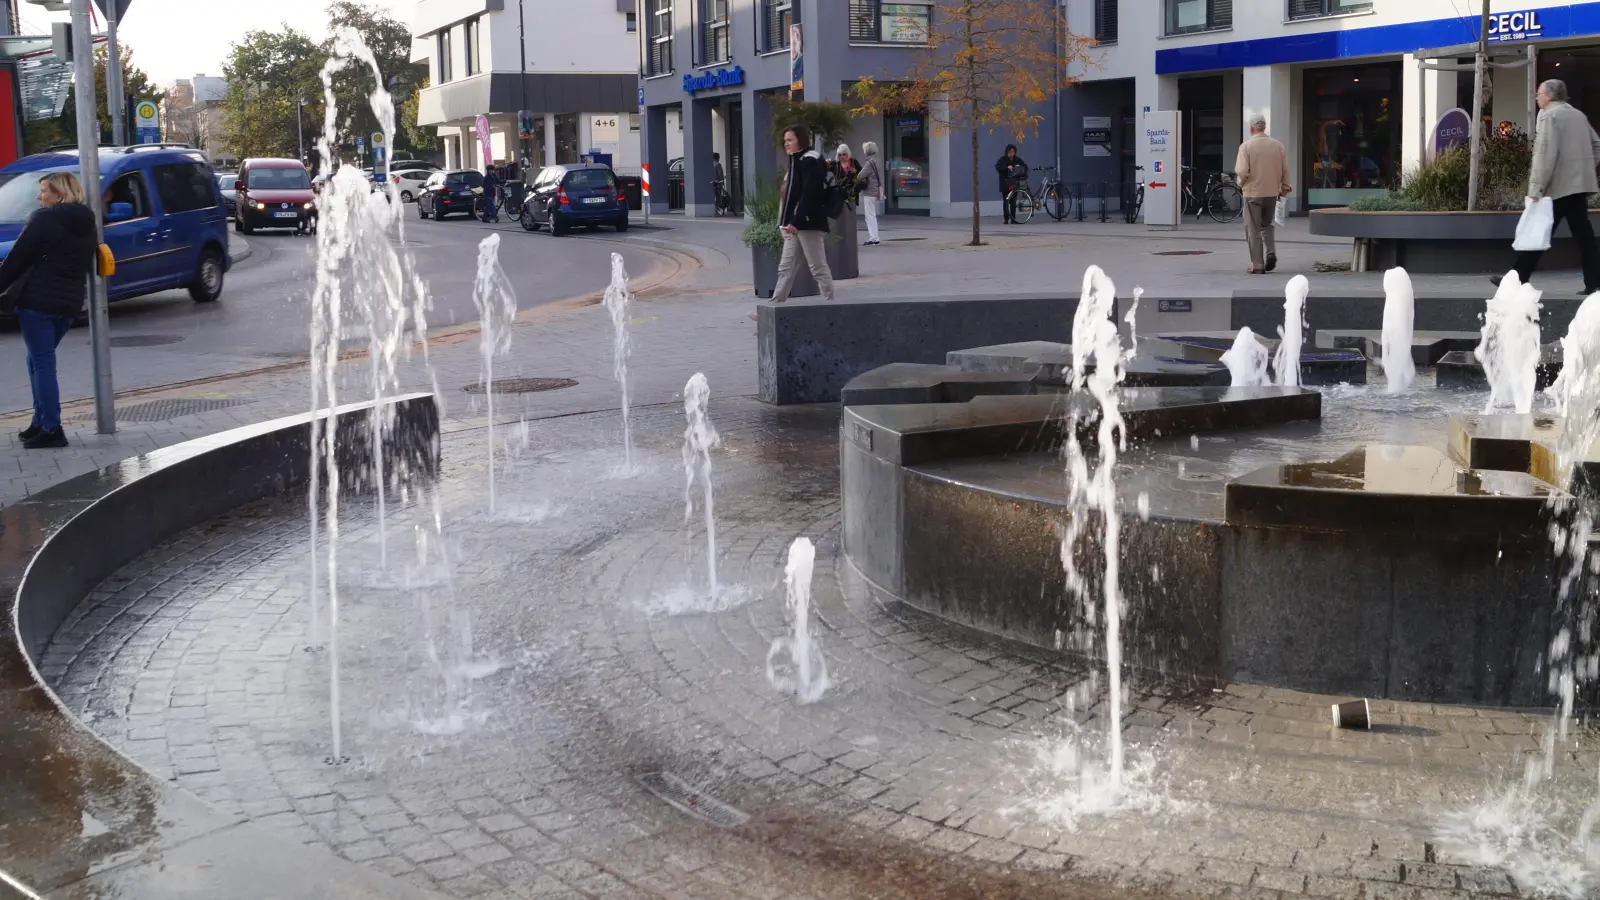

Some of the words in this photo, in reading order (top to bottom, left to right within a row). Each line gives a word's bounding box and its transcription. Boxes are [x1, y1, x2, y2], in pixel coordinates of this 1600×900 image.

[1488, 12, 1541, 34] CECIL
[1146, 129, 1170, 137] Sparda-
[1440, 126, 1464, 137] CECIL
